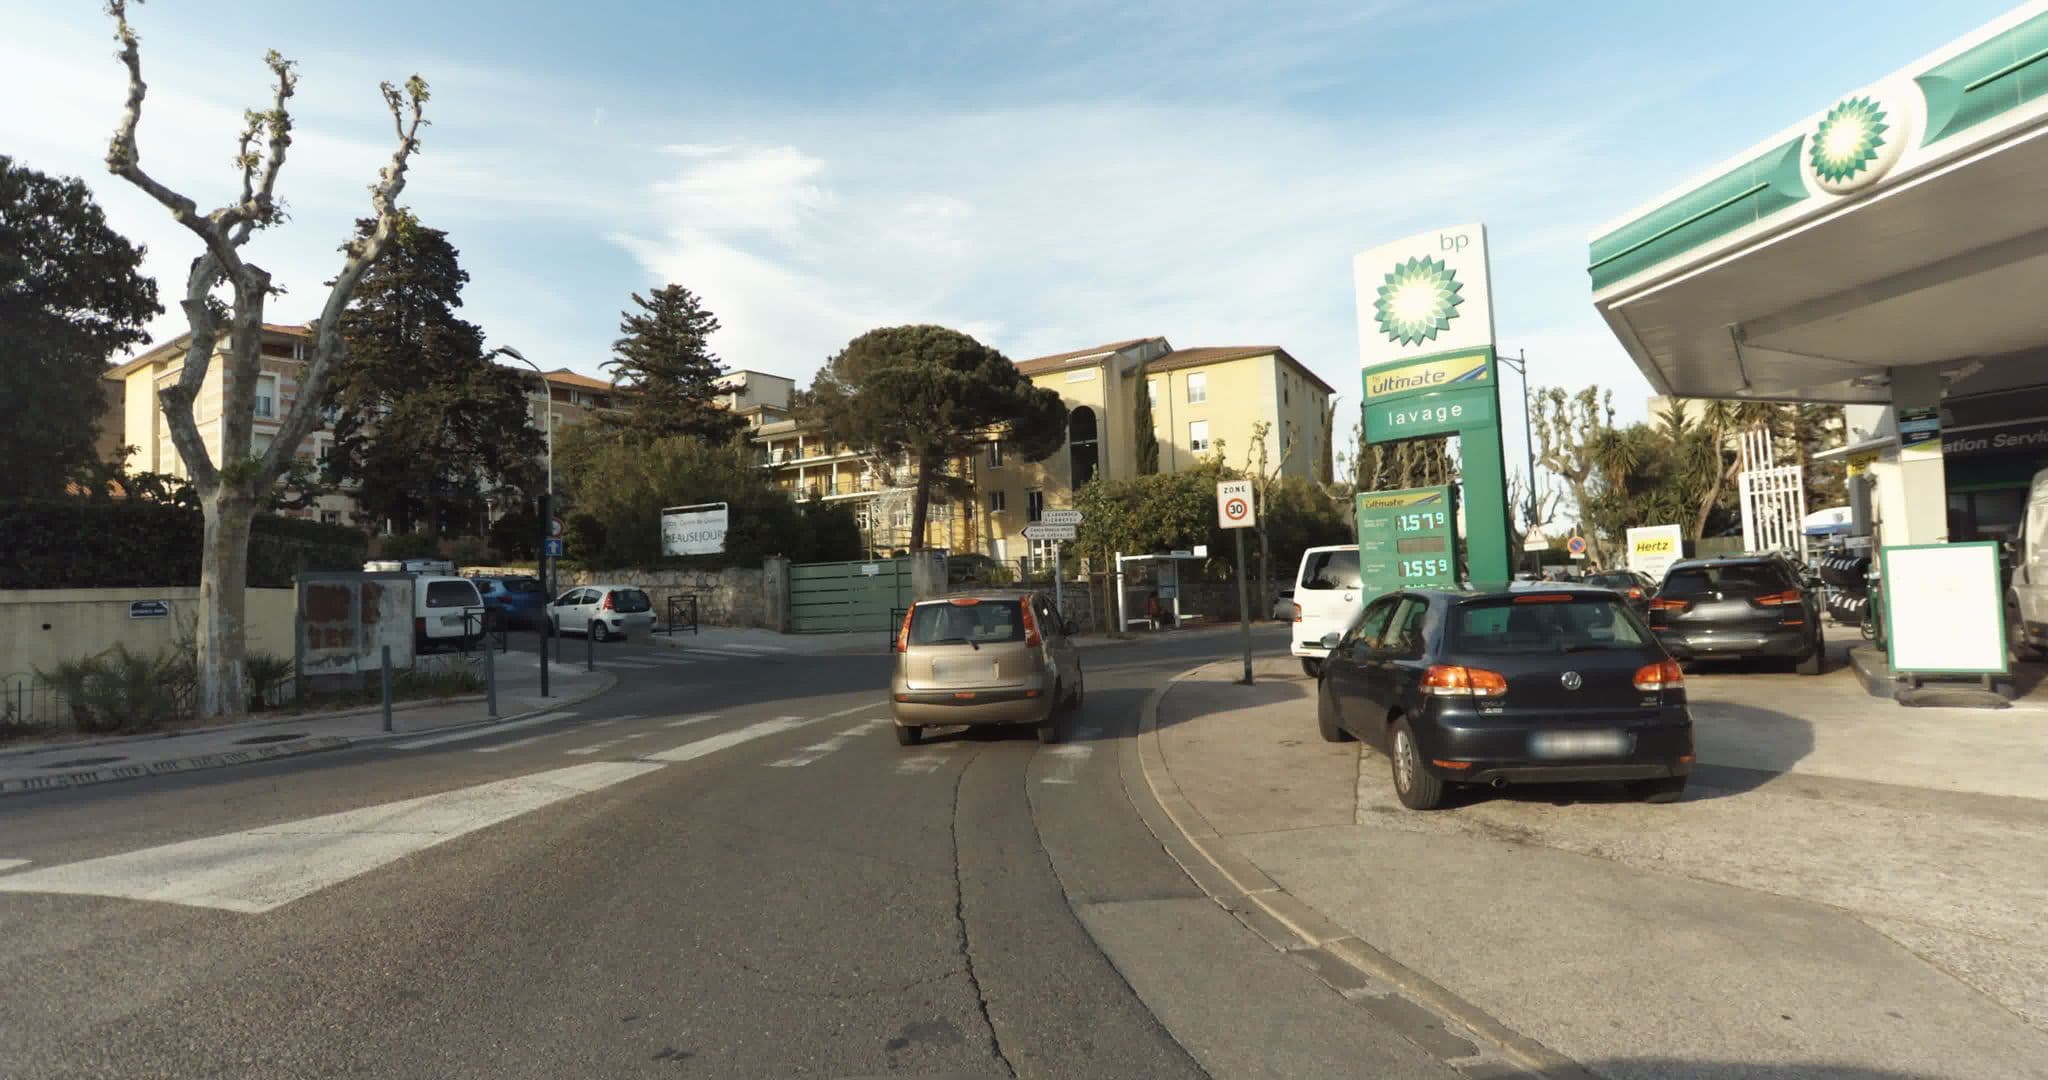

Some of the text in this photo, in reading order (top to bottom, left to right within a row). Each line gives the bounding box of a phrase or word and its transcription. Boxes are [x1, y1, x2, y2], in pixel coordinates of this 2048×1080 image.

[1440, 233, 1469, 252] bp
[1372, 369, 1446, 395] ultimate
[1388, 404, 1463, 426] lavage
[1943, 437, 1988, 454] ation
[1223, 485, 1246, 494] ZONE
[1230, 504, 1243, 514] 30
[1637, 541, 1669, 552] Hertz
